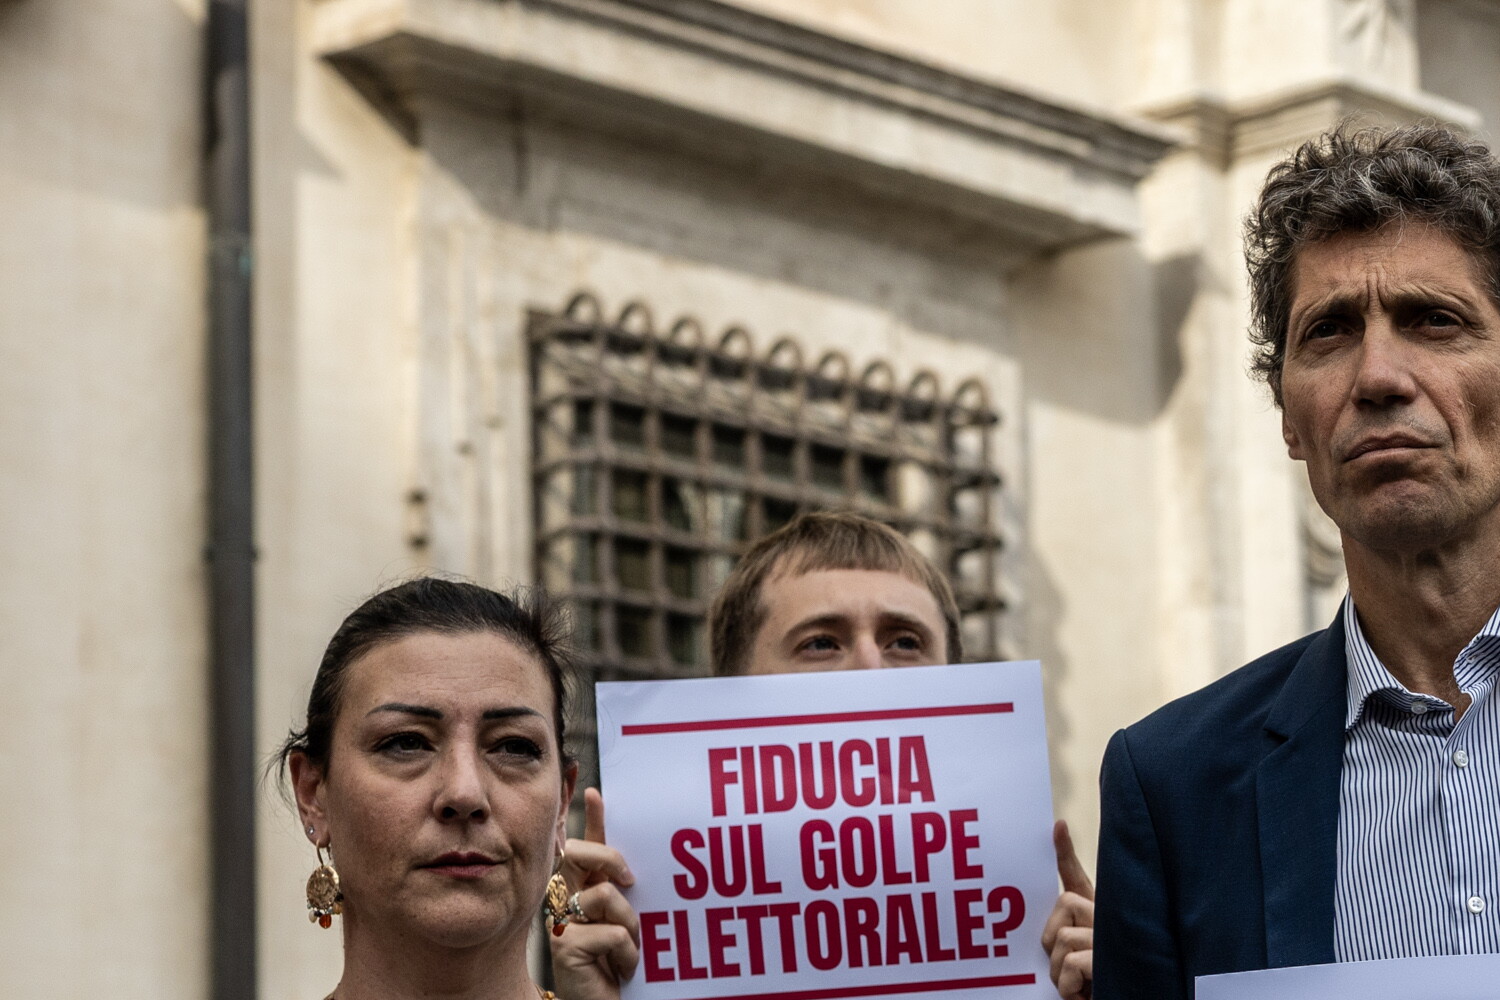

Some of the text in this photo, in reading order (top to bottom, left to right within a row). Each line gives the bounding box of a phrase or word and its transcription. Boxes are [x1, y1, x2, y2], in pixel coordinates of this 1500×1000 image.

[708, 736, 935, 817] FIDUCIA
[671, 809, 984, 900] SUL GOLPE
[639, 886, 1025, 983] ELETTORALE?
